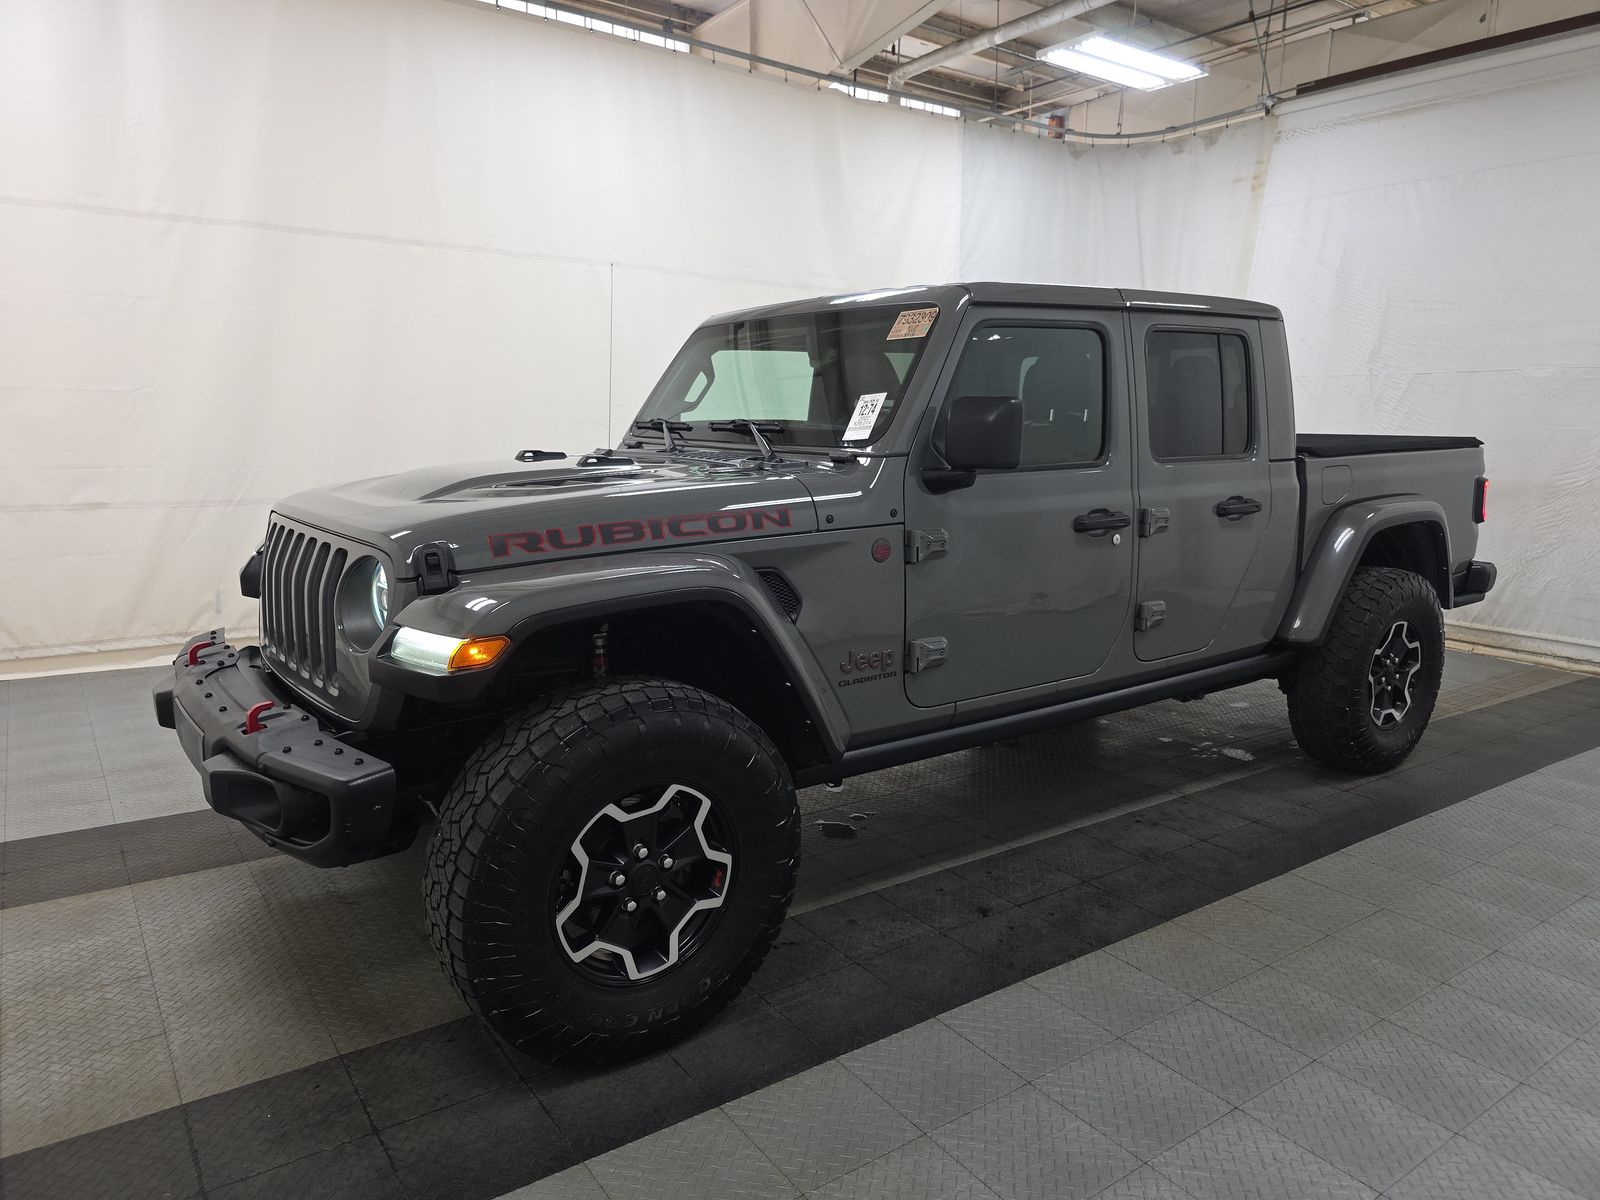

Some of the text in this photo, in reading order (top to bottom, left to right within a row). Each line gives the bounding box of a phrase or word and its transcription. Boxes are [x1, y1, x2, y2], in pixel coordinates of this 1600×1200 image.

[488, 507, 792, 559] RUBICON
[840, 649, 893, 673] Jeep
[838, 671, 897, 687] GLADIATOR
